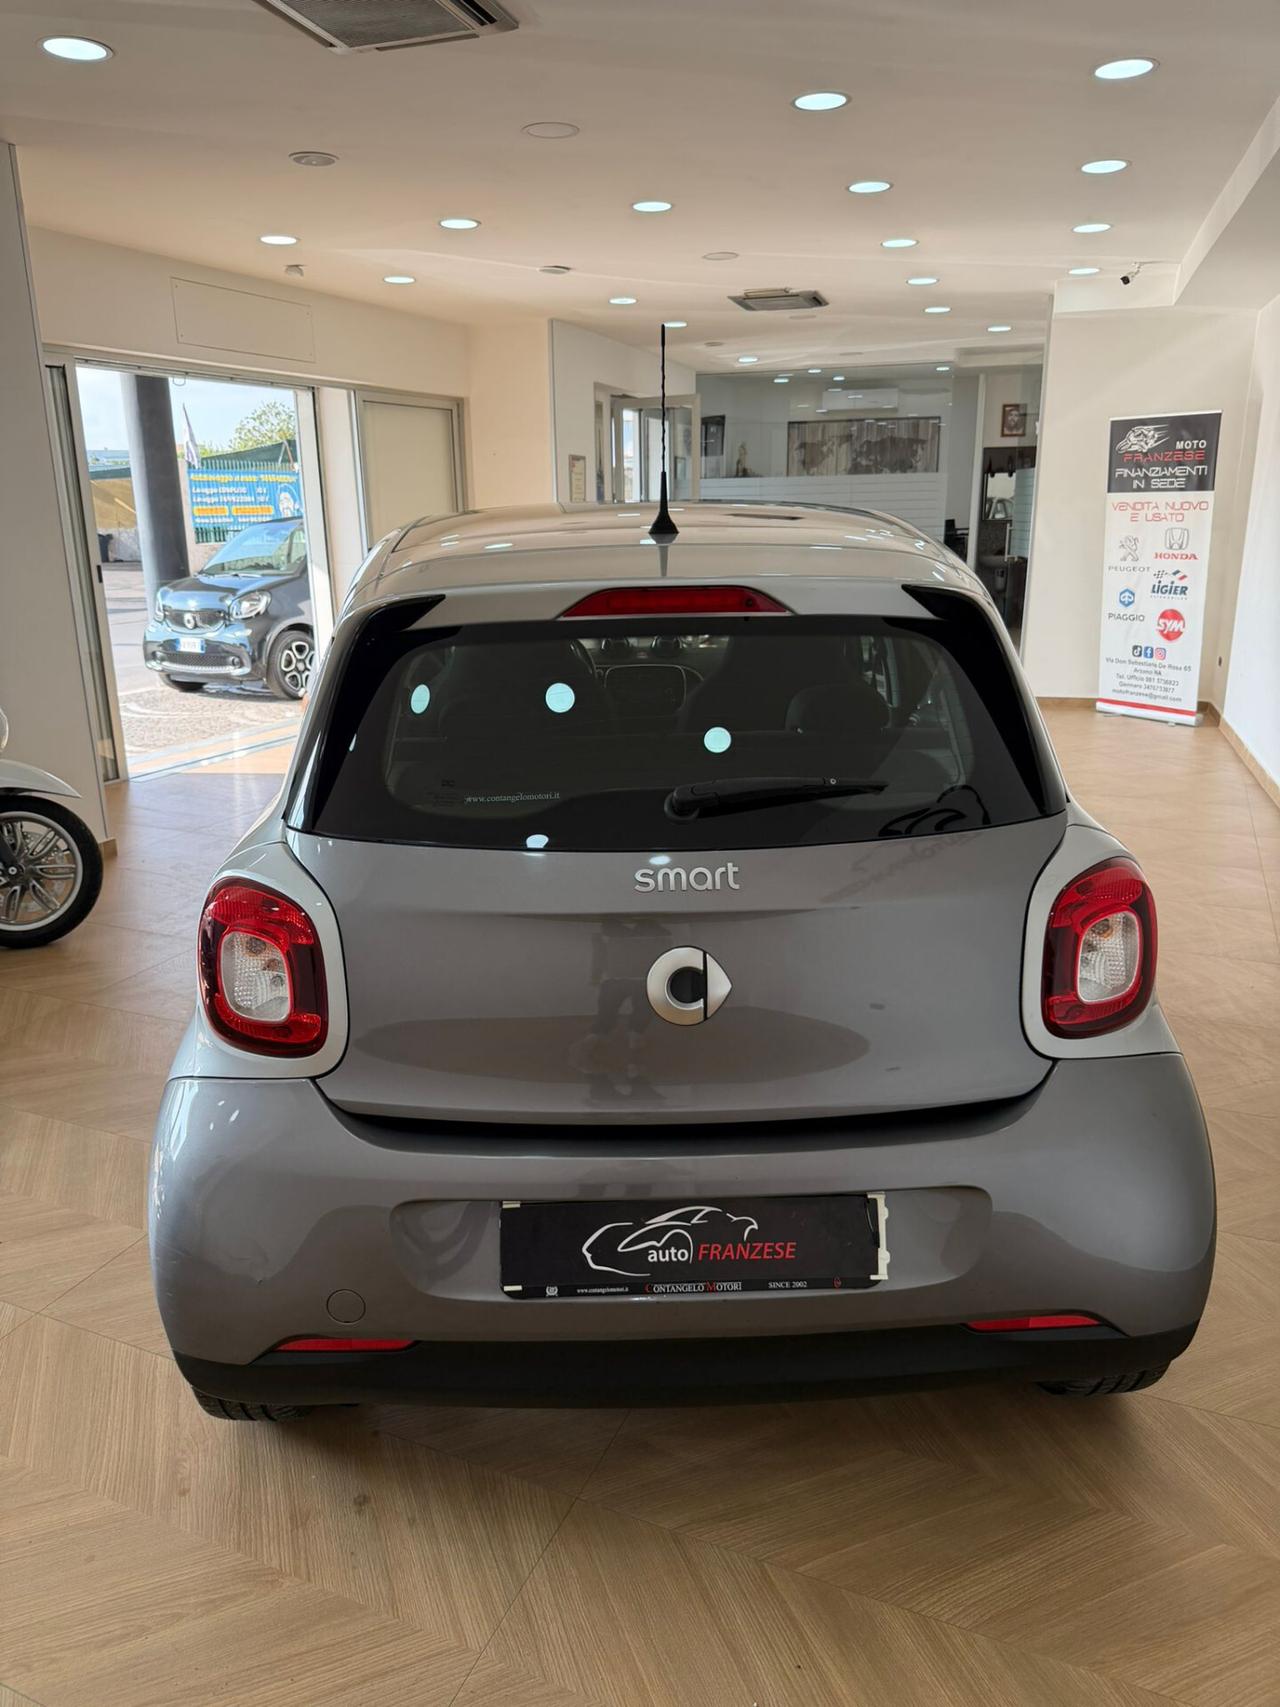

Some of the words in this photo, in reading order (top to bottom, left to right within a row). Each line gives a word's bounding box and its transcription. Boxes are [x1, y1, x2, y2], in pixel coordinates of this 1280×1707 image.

[1176, 440, 1206, 449] MOTO
[1122, 450, 1205, 462] FRANZESE
[1115, 465, 1208, 478] FINANZIAMENTI
[1132, 479, 1144, 489] IN
[1151, 478, 1186, 489] SEDE
[1112, 502, 1159, 511] VENDITA
[1165, 501, 1209, 511] NUOVO
[1130, 513, 1139, 522] E
[1145, 513, 1184, 522] USATO
[1154, 552, 1198, 561] HONDA
[1108, 612, 1145, 622] PIAGGIO
[1157, 618, 1184, 634] SYM
[634, 862, 740, 892] smart
[647, 1246, 688, 1262] auto
[699, 1242, 797, 1261] FRANZESE
[644, 1282, 704, 1294] CONTANGELO
[705, 1280, 742, 1292] MOTORI
